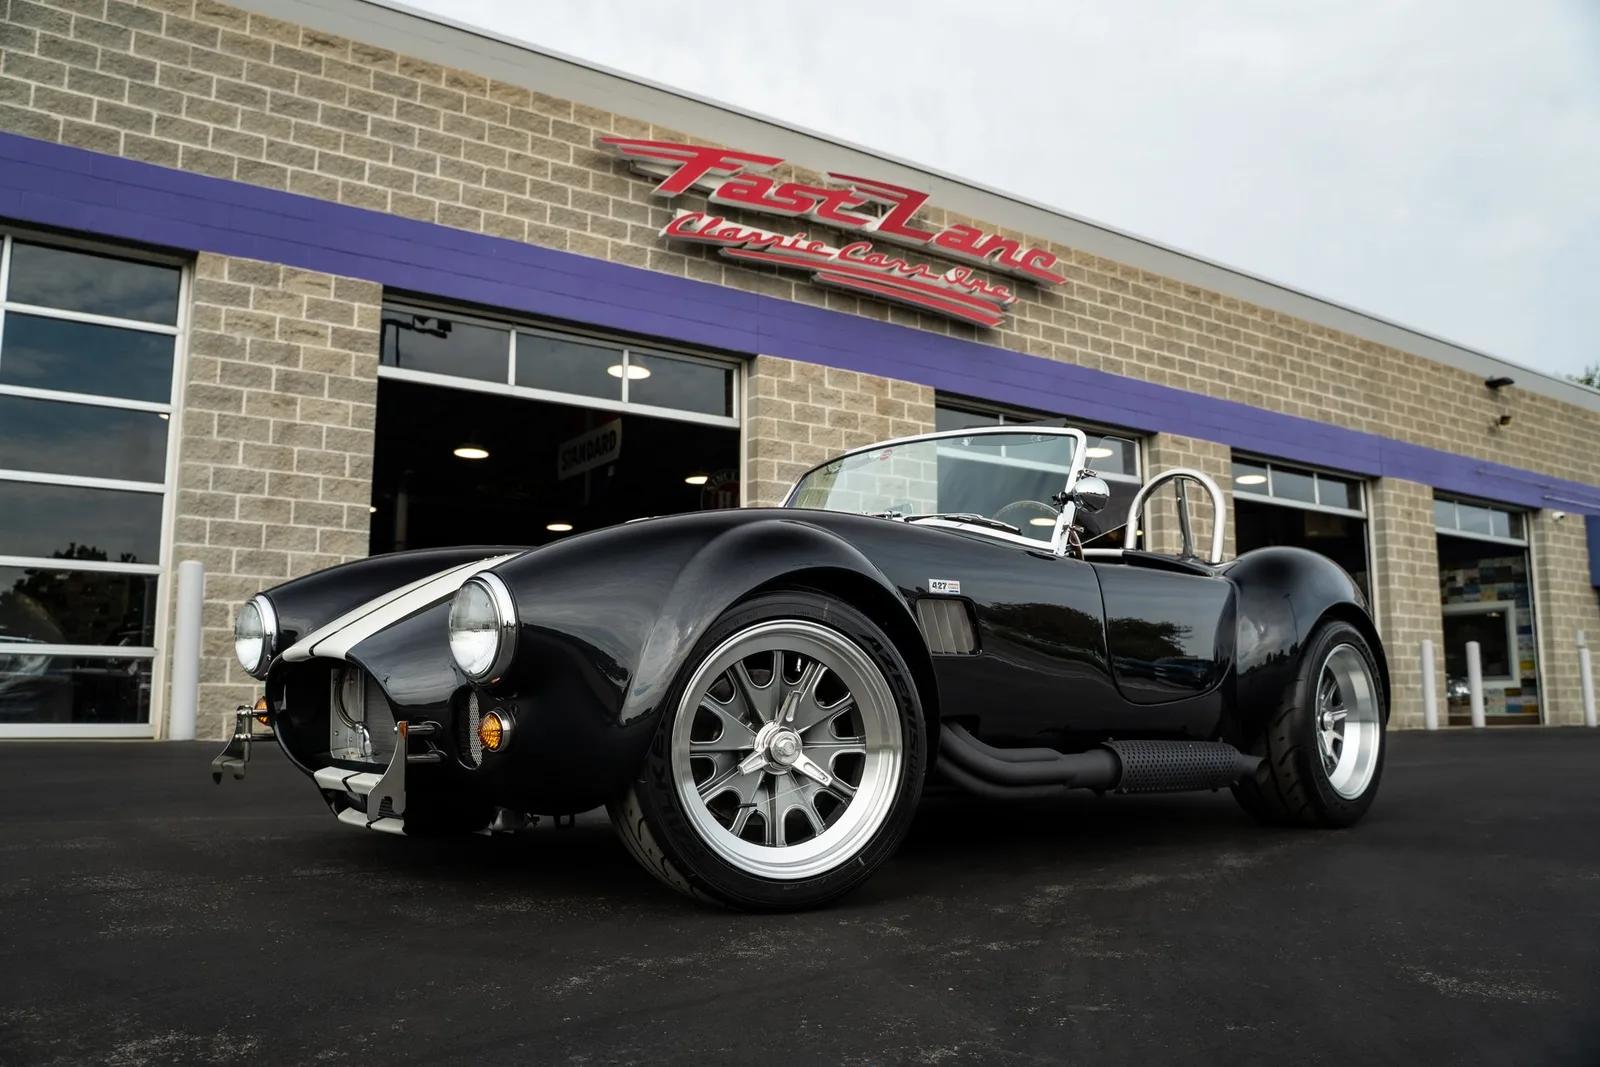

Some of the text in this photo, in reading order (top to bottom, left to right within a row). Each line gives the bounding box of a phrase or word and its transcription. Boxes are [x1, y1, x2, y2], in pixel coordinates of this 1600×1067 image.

[600, 136, 870, 226] Fast
[665, 211, 836, 257] Classic
[836, 241, 942, 280] Cars
[932, 581, 947, 590] 427
